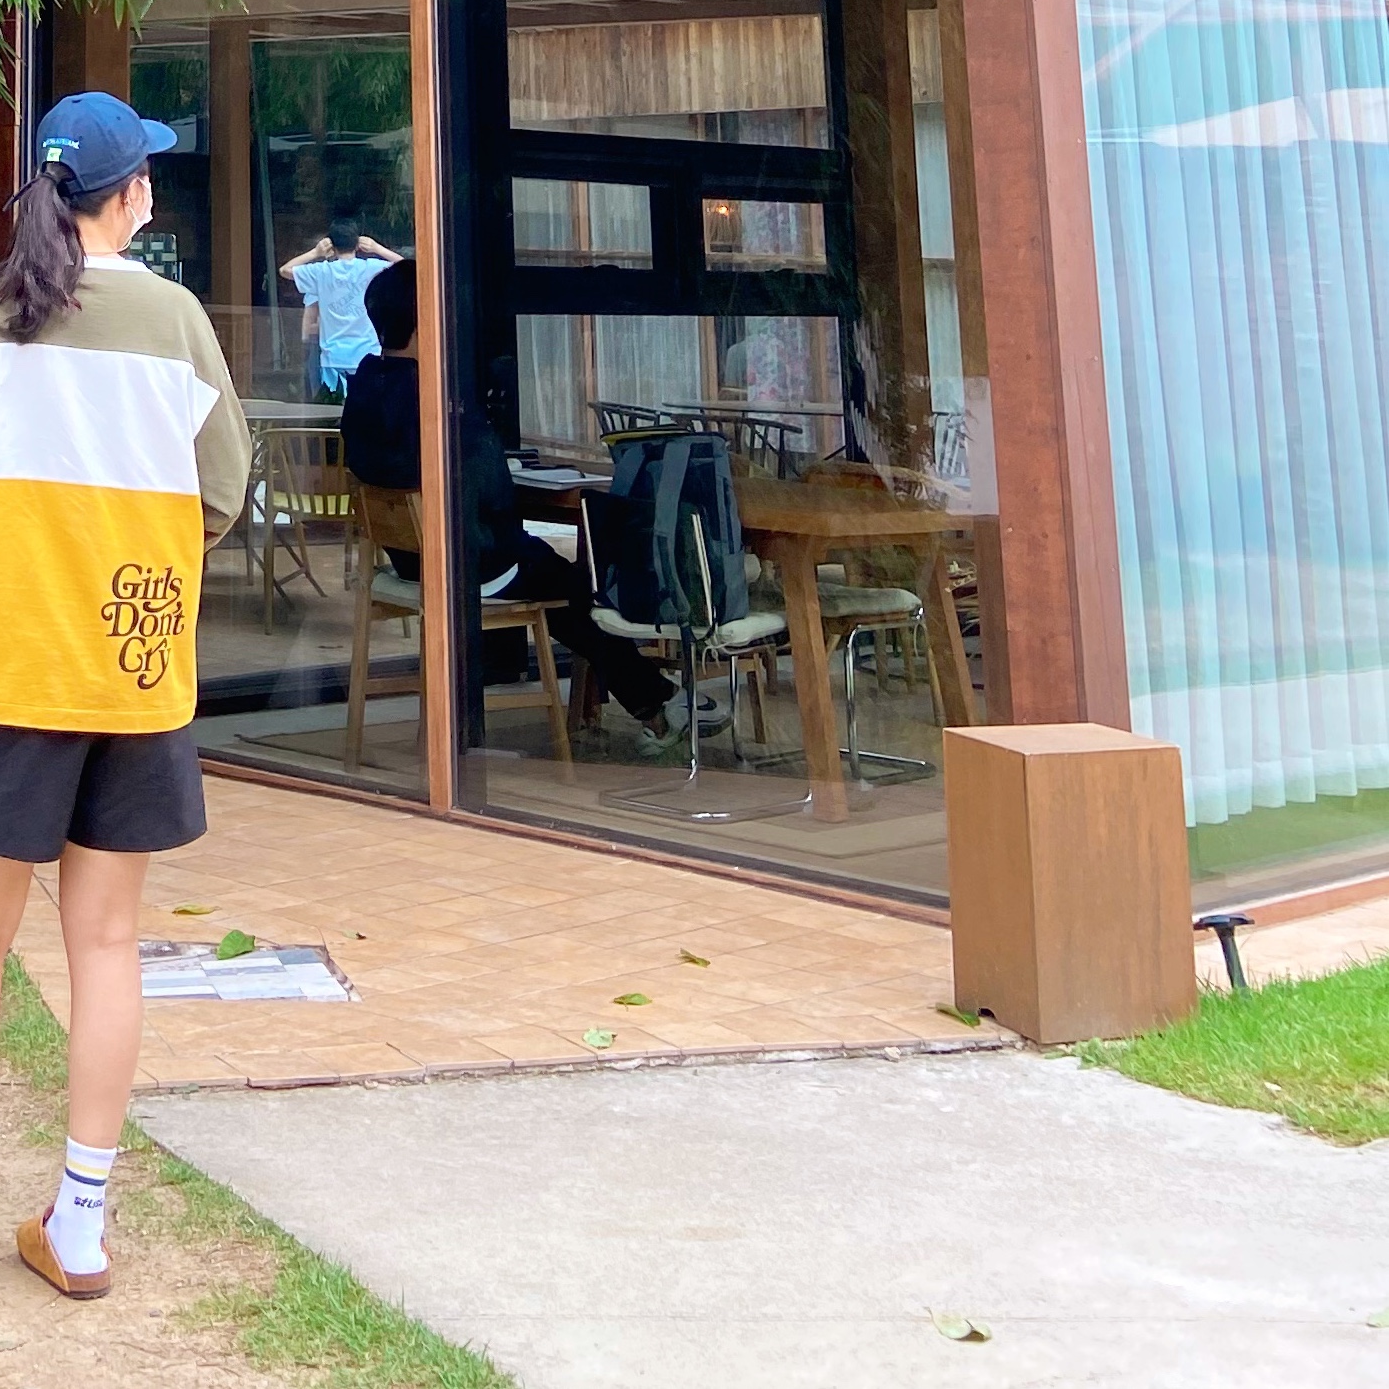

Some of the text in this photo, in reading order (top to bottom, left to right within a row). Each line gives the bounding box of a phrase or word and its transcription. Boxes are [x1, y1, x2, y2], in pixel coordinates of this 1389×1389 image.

[112, 563, 183, 613] Girls
[101, 601, 185, 637] Don't
[119, 636, 171, 690] Cry
